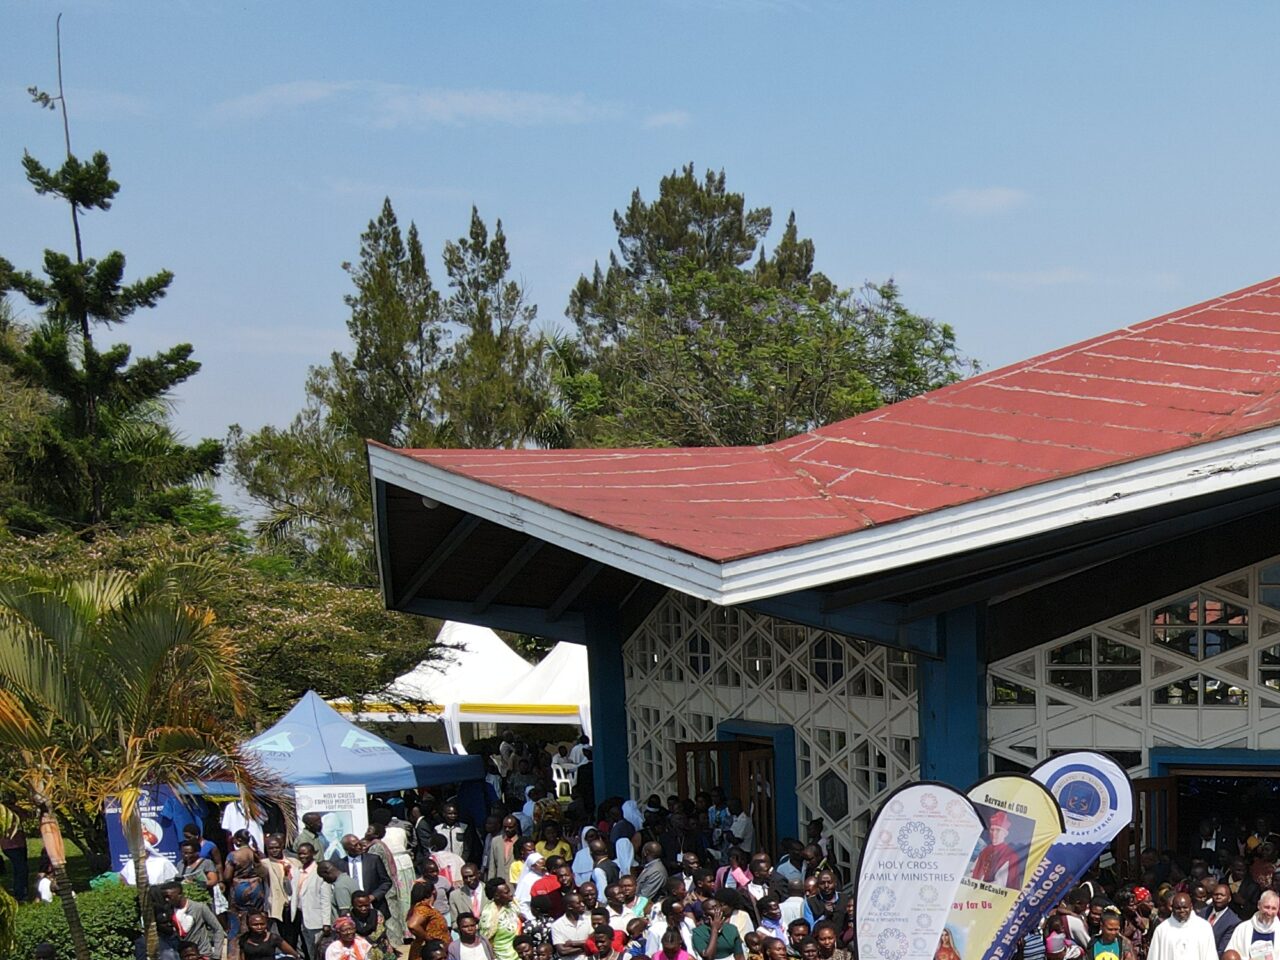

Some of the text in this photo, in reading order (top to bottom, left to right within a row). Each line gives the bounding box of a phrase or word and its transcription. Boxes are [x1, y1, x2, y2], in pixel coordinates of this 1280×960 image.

[984, 794, 1007, 808] Servant
[1016, 804, 1028, 814] GOD
[1094, 813, 1114, 832] AFRICA
[878, 861, 938, 870] HOLY CROSS
[864, 873, 955, 882] FAMILY MINISTRIES
[960, 878, 978, 890] ishop
[966, 901, 978, 909] for
[981, 900, 992, 909] Us
[1002, 908, 1030, 945] HOLY
[1028, 864, 1066, 907] CROSS
